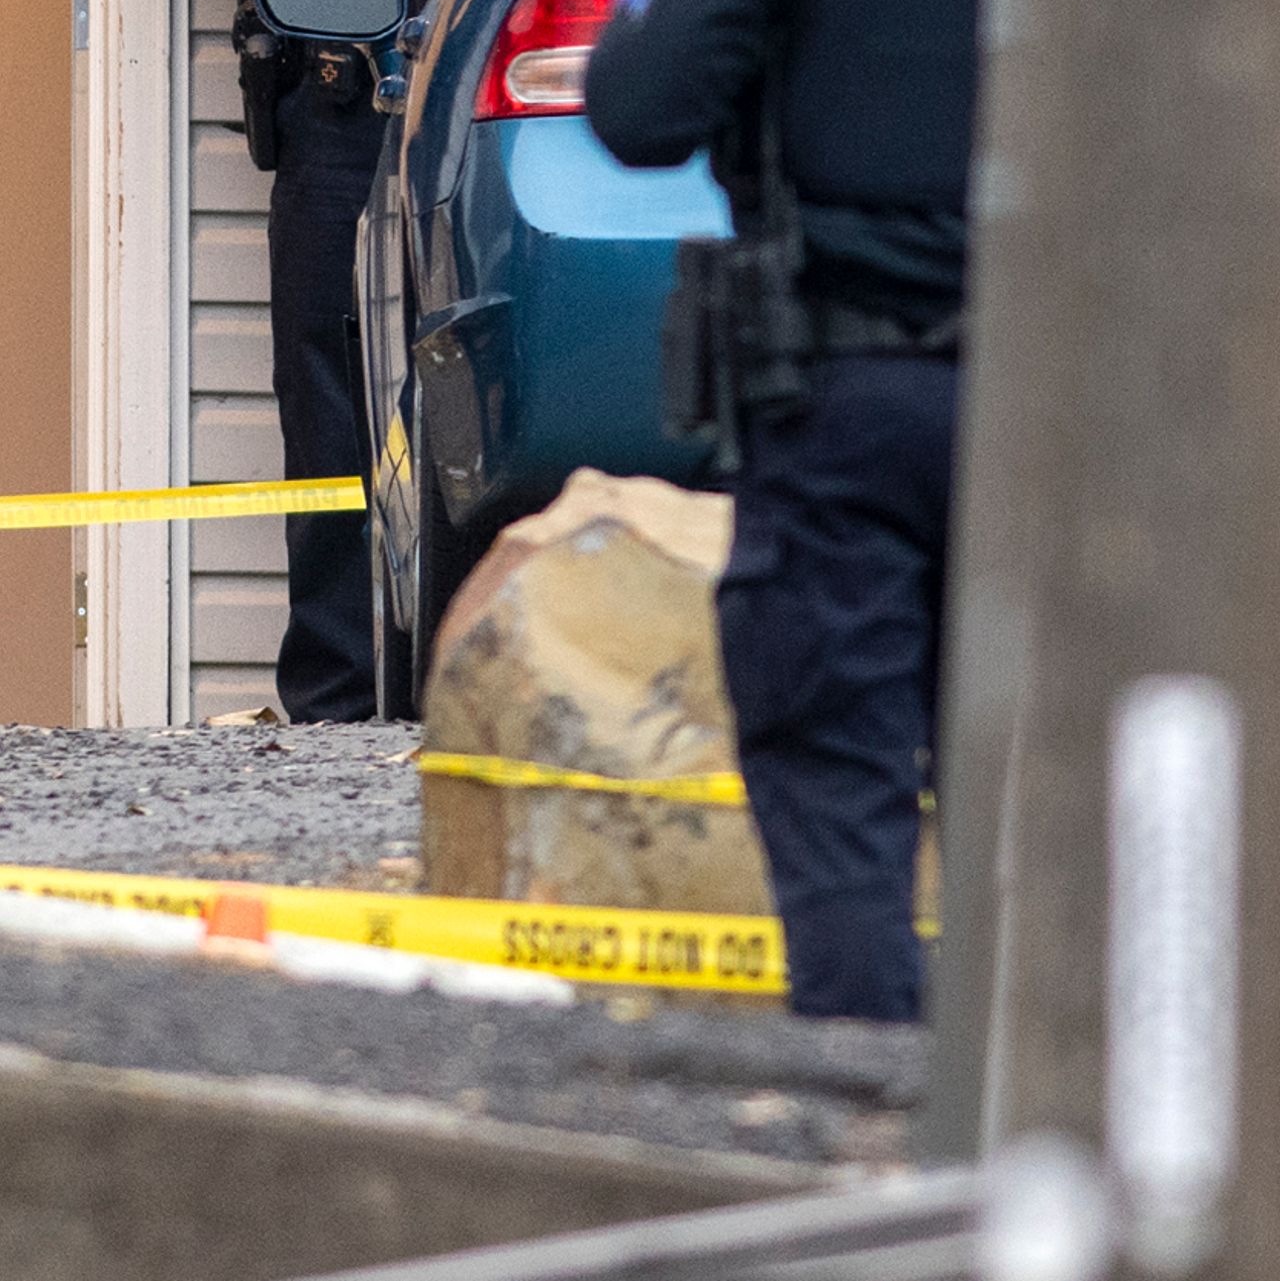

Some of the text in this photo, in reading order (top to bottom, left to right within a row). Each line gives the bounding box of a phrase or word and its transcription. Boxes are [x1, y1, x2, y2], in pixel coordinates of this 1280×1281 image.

[502, 918, 766, 979] DO NOT CROSS
